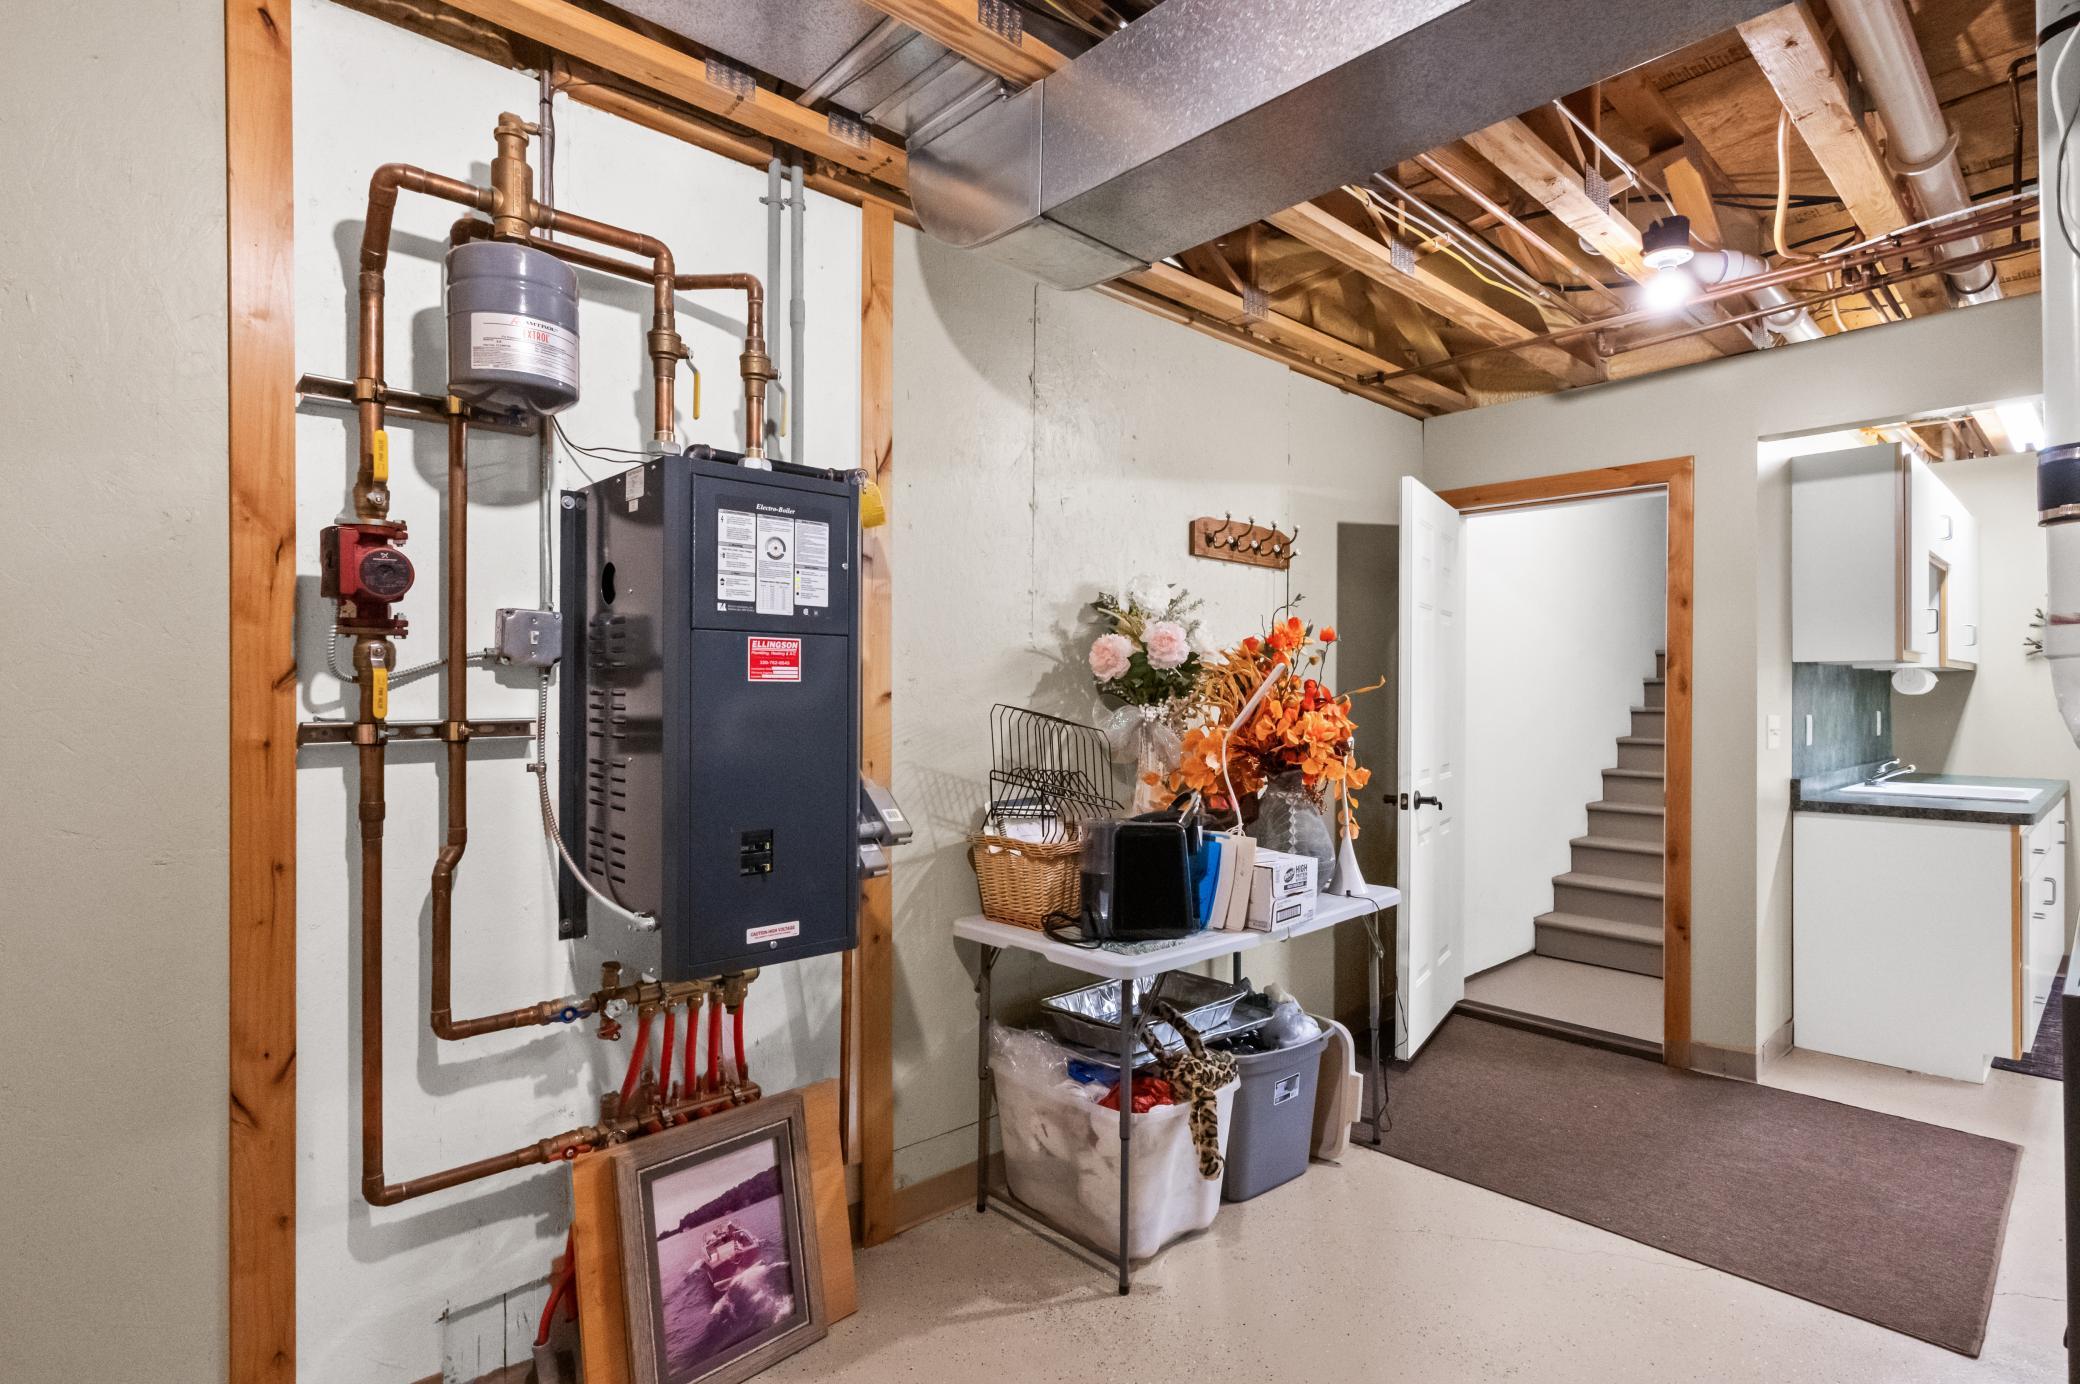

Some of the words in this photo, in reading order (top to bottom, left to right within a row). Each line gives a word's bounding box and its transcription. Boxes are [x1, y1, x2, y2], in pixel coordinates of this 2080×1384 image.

[755, 503, 796, 515] Electro-Boiler
[752, 640, 798, 649] ELLINGSON
[1296, 864, 1307, 873] HIGH
